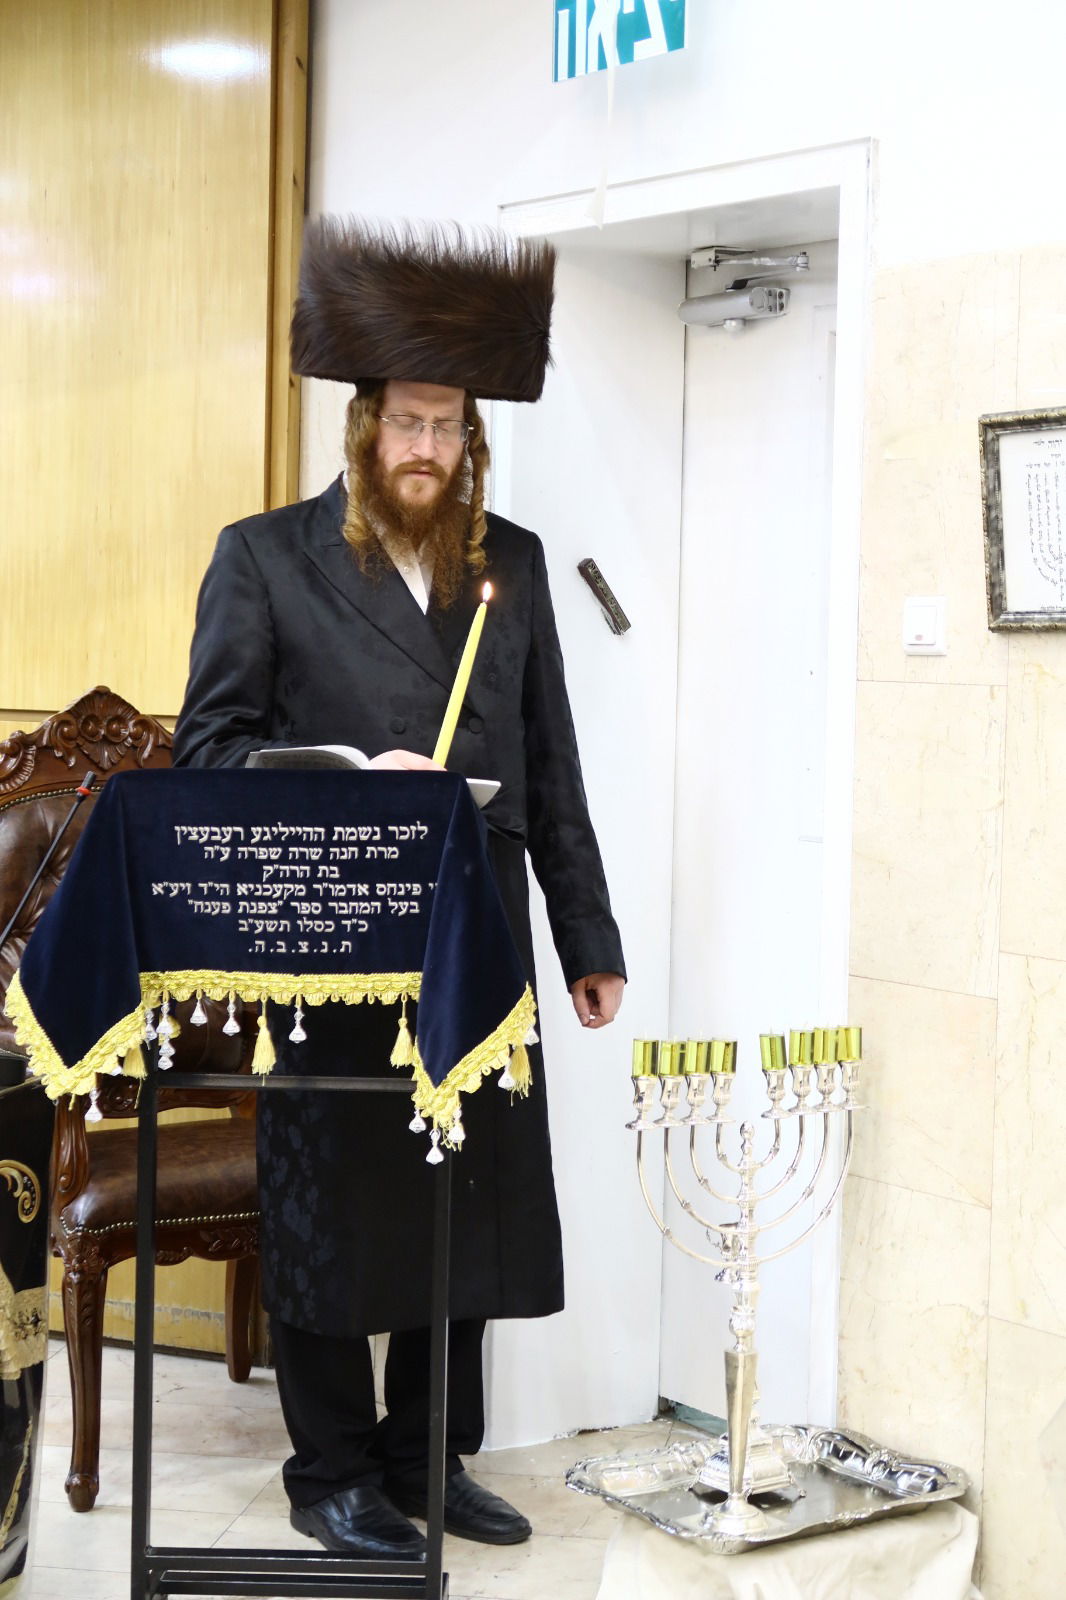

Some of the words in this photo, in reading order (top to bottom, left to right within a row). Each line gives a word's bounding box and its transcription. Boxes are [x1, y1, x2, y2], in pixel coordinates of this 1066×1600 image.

[332, 826, 381, 841] נשמת
[388, 821, 428, 840] לזכר
[204, 845, 231, 861] ע"ה
[238, 847, 282, 859] שפרה
[289, 847, 323, 860] שרה
[330, 847, 358, 860] חנה
[365, 847, 399, 859] מרת
[263, 864, 310, 882] הרה"ק
[317, 866, 340, 878] בת
[198, 882, 230, 895] הי"ד
[313, 882, 369, 896] אדמו"ר
[376, 883, 422, 895] פינחס
[290, 902, 322, 914] ספר
[328, 902, 381, 914] המחבר
[388, 898, 420, 916] בעל
[239, 919, 290, 934] תשע"ב
[297, 917, 335, 932] כסלו
[341, 919, 368, 932] כ"ד
